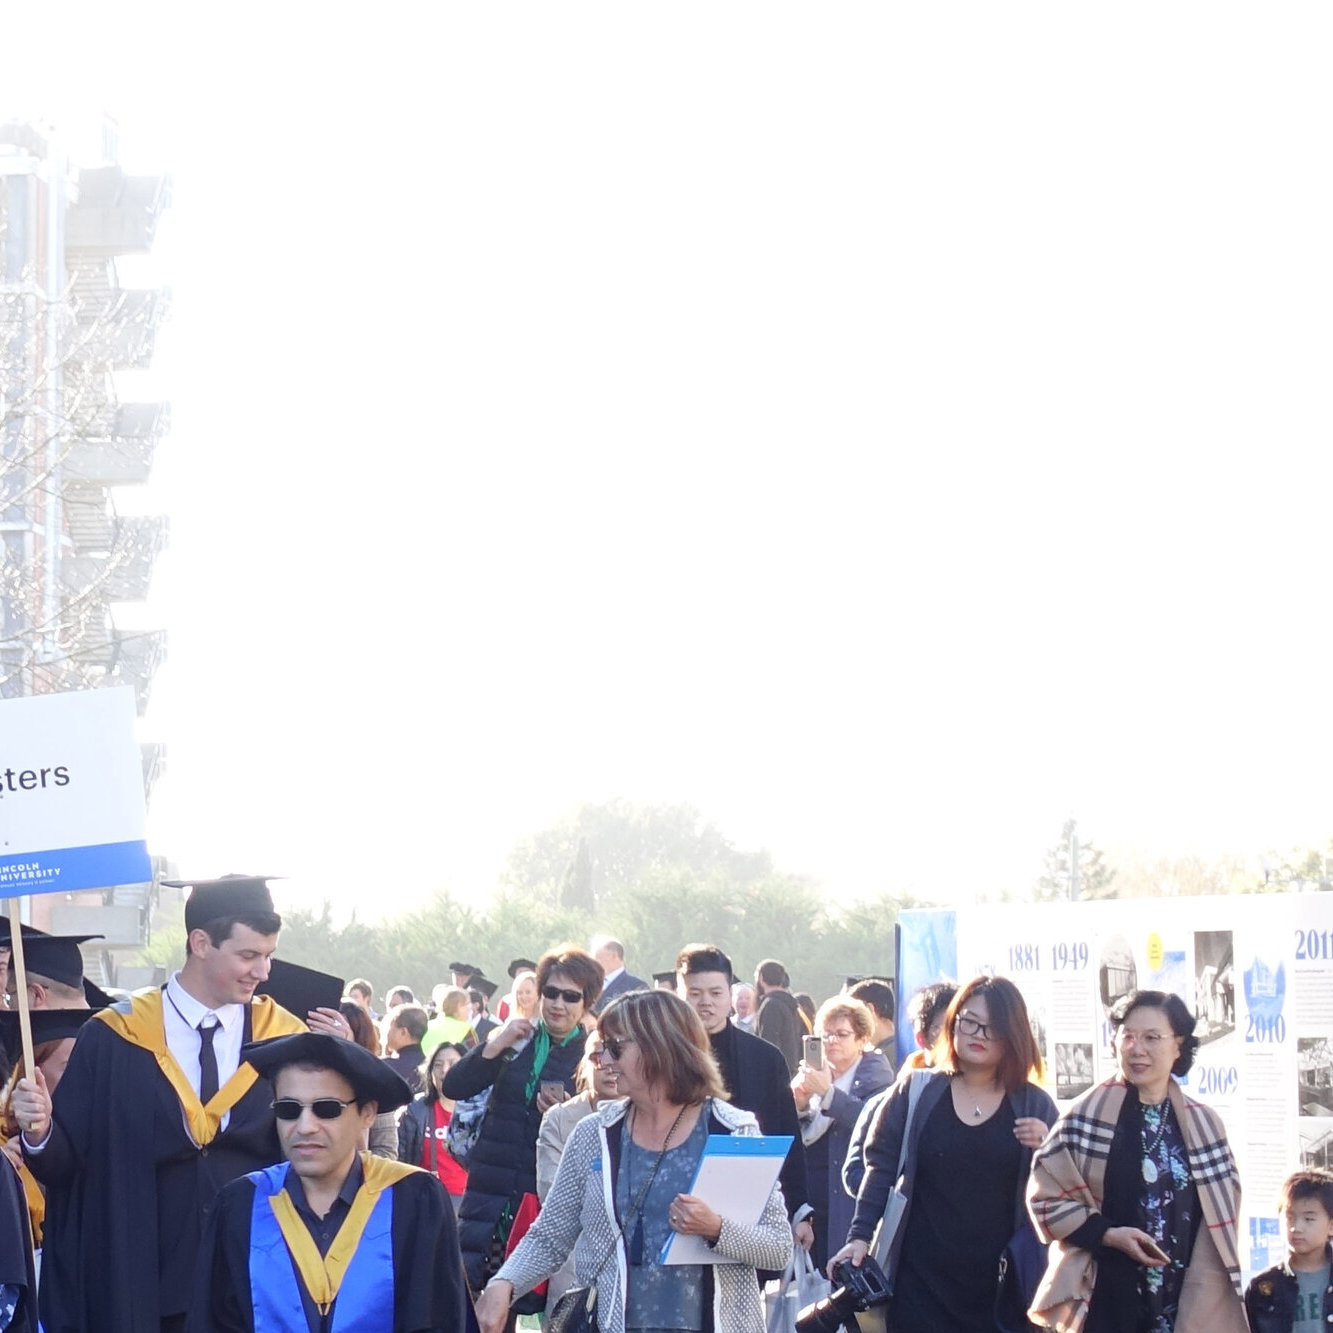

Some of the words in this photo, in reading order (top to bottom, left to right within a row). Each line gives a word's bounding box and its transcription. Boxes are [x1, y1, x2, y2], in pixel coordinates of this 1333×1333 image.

[1009, 943, 1040, 971] 1881
[1052, 942, 1089, 971] 1949
[1244, 1014, 1286, 1043] 2010
[1197, 1066, 1238, 1095] 2009
